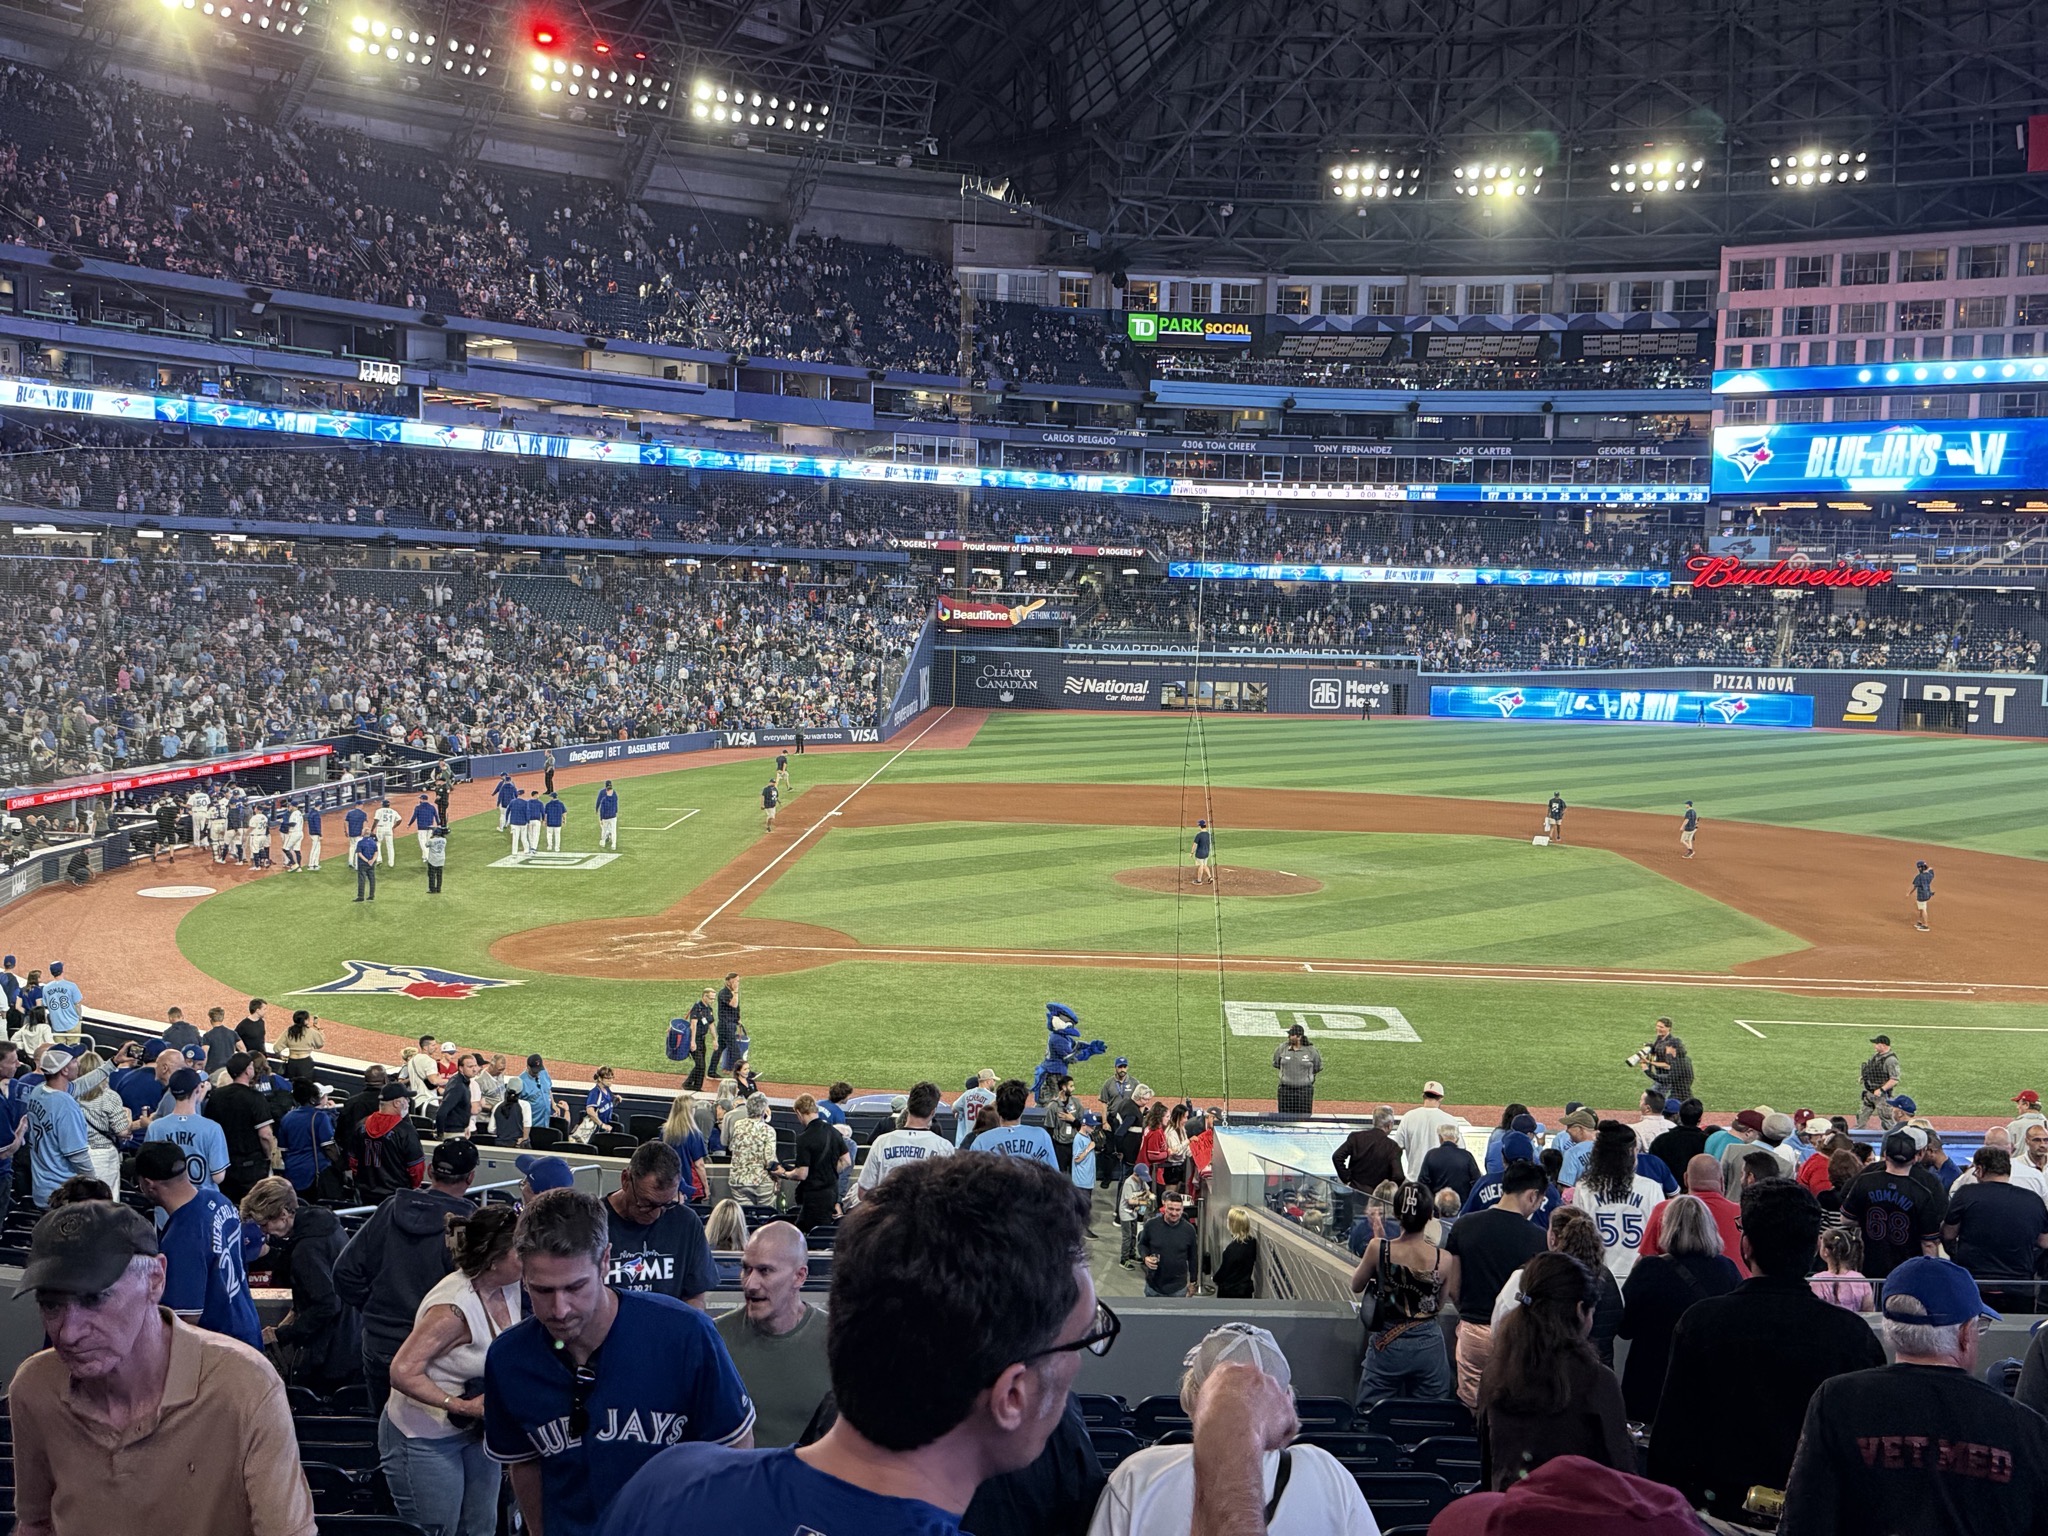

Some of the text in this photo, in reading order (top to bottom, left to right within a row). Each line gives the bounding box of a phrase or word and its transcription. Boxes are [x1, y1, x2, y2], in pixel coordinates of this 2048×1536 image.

[1131, 317, 1252, 336] TD PARK SOCIAL
[359, 366, 401, 385] KPMG
[72, 391, 94, 411] WIN
[547, 436, 570, 458] WIN
[1042, 433, 1116, 446] CARLOS DELGADO
[1181, 440, 1257, 451] 4306 TOM CHEEK
[1313, 444, 1392, 455] TONY FERNANDEZ
[1456, 446, 1512, 456] JOE CARTER
[1598, 446, 1661, 456] GEORGE BELL
[1804, 434, 1872, 478] BLUE
[1872, 433, 1943, 477] JAYS
[1600, 492, 1607, 500] 0
[962, 542, 1073, 556] Proud owner of the Blue Jays
[1105, 548, 1132, 556] ROGERS
[1686, 555, 1893, 588] Budweiser
[953, 609, 1008, 621] BeautiTone
[960, 655, 976, 664] 328
[1345, 680, 1389, 695] Here's
[1713, 673, 1795, 693] PIZZA NOVA
[1120, 694, 1145, 702] Rental
[1642, 692, 1680, 721] WIN
[723, 731, 757, 746] VISA
[763, 734, 796, 742] everywher
[848, 729, 879, 742] VISA
[569, 745, 621, 762] theScore BET
[628, 741, 670, 755] BASELINE BOX
[49, 995, 70, 1011] 68
[165, 1131, 196, 1147] KIRK
[883, 1146, 925, 1161] GUERRERO
[1594, 1193, 1644, 1208] MARTIN
[1867, 1189, 1914, 1211] ROMANO
[212, 1204, 233, 1254] GUERRERO
[1595, 1212, 1644, 1249] 55
[1866, 1206, 1910, 1246] 68
[527, 1407, 689, 1458] LUE JAYS
[1856, 1436, 2013, 1483] VET MED
